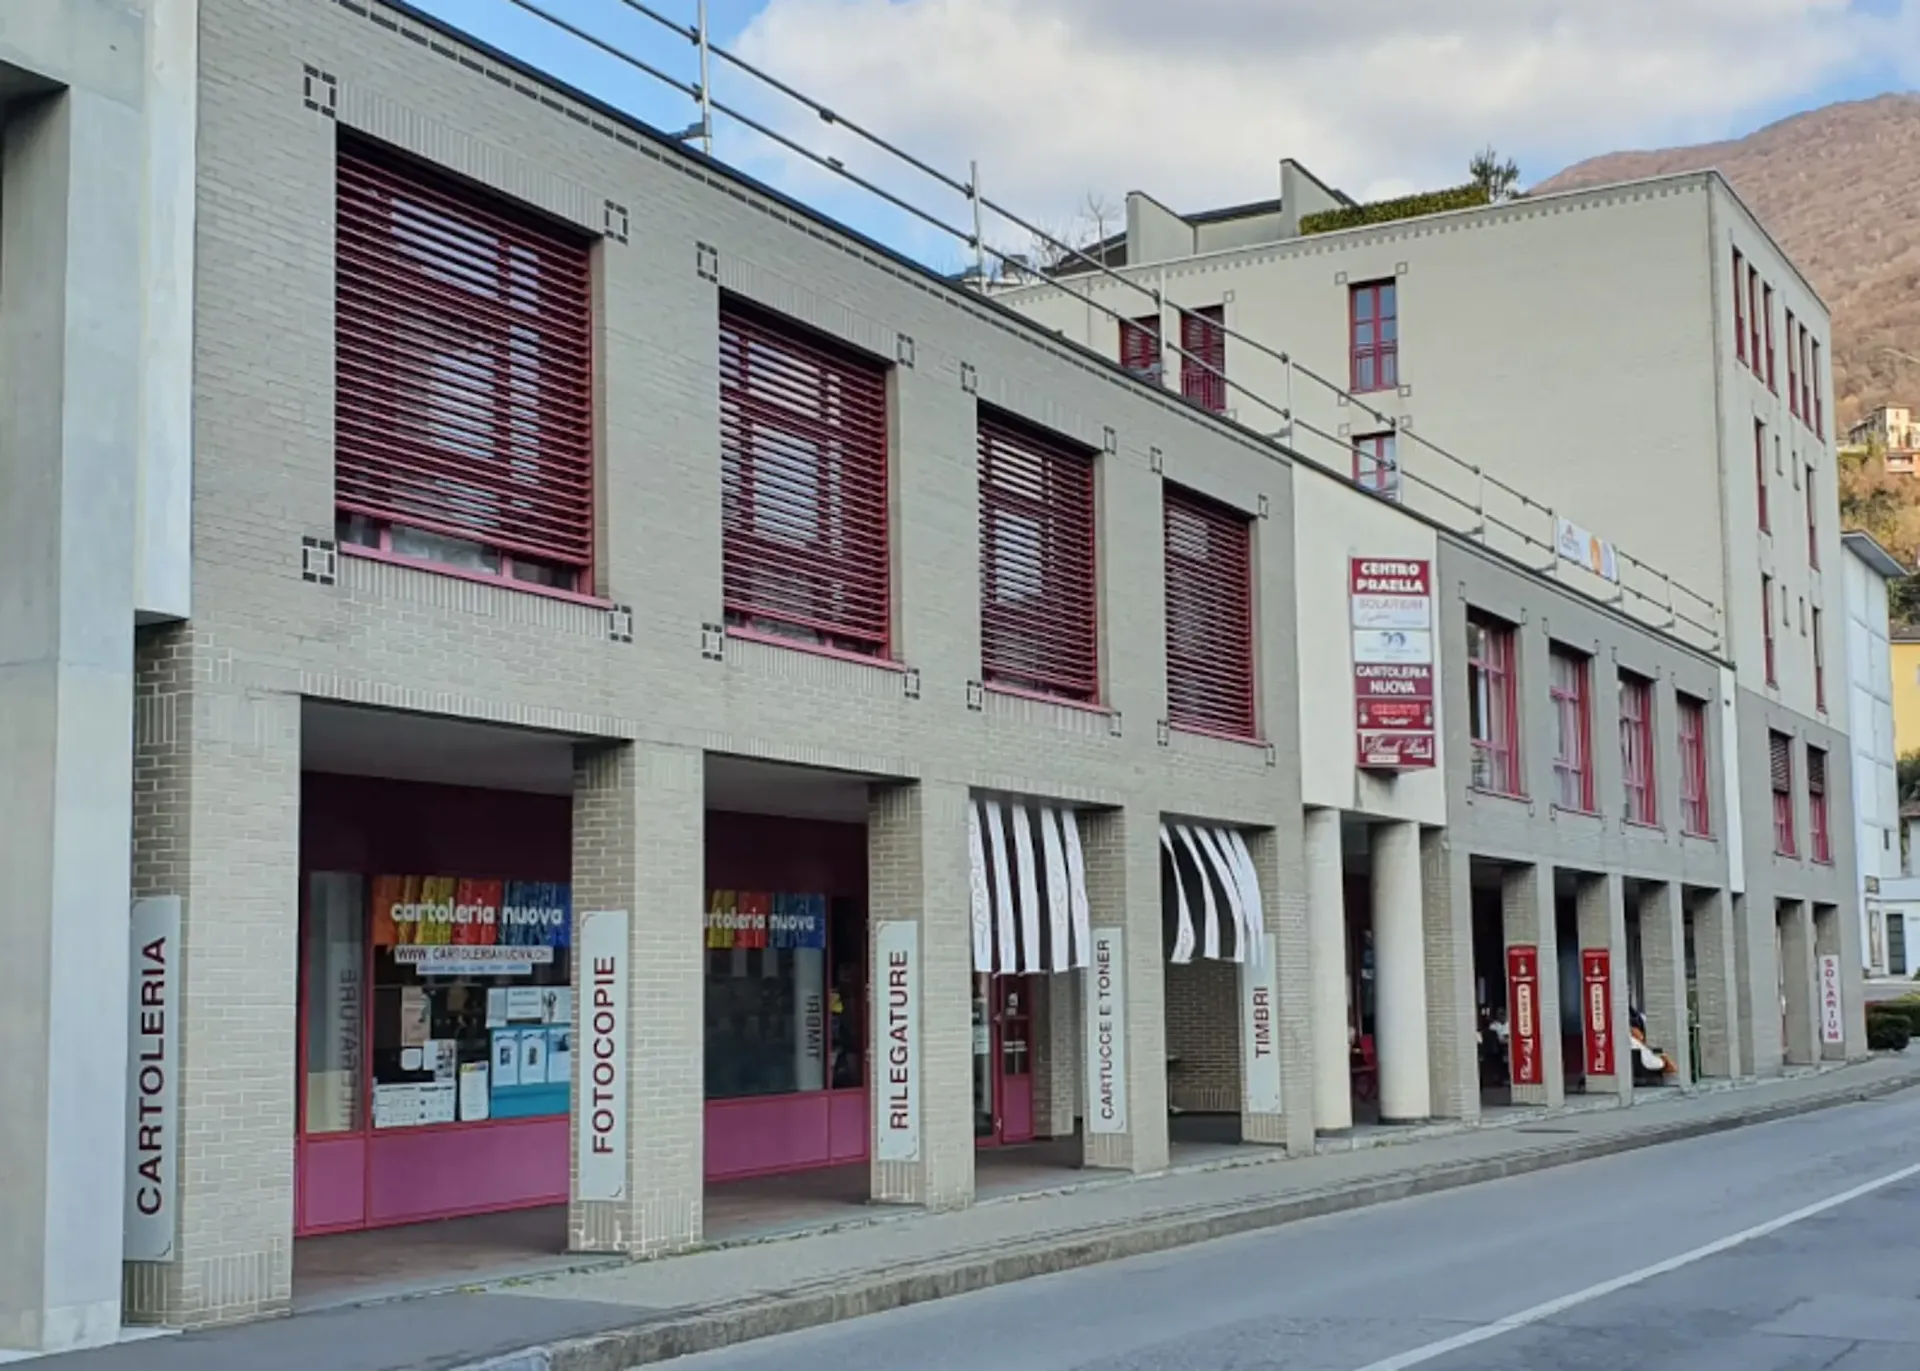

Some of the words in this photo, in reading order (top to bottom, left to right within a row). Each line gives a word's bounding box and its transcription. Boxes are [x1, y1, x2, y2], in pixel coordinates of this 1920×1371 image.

[1361, 562, 1420, 576] CENTRO
[1356, 665, 1430, 678] CARTOLERIA
[1370, 680, 1416, 694] NUOVA
[390, 897, 496, 923] cartoleria
[502, 905, 563, 925] nuova
[768, 913, 815, 930] nuova
[1097, 939, 1111, 999] TONER
[1099, 1005, 1111, 1016] E
[1253, 987, 1271, 1059] TIMBRI
[1824, 959, 1839, 1040] SOLARIUM
[592, 957, 615, 1154] FOTOCOPIE
[889, 951, 909, 1130] RILEGATURE
[1099, 1021, 1114, 1120] CARTUCCE
[137, 936, 166, 1215] CARTOLERIA
